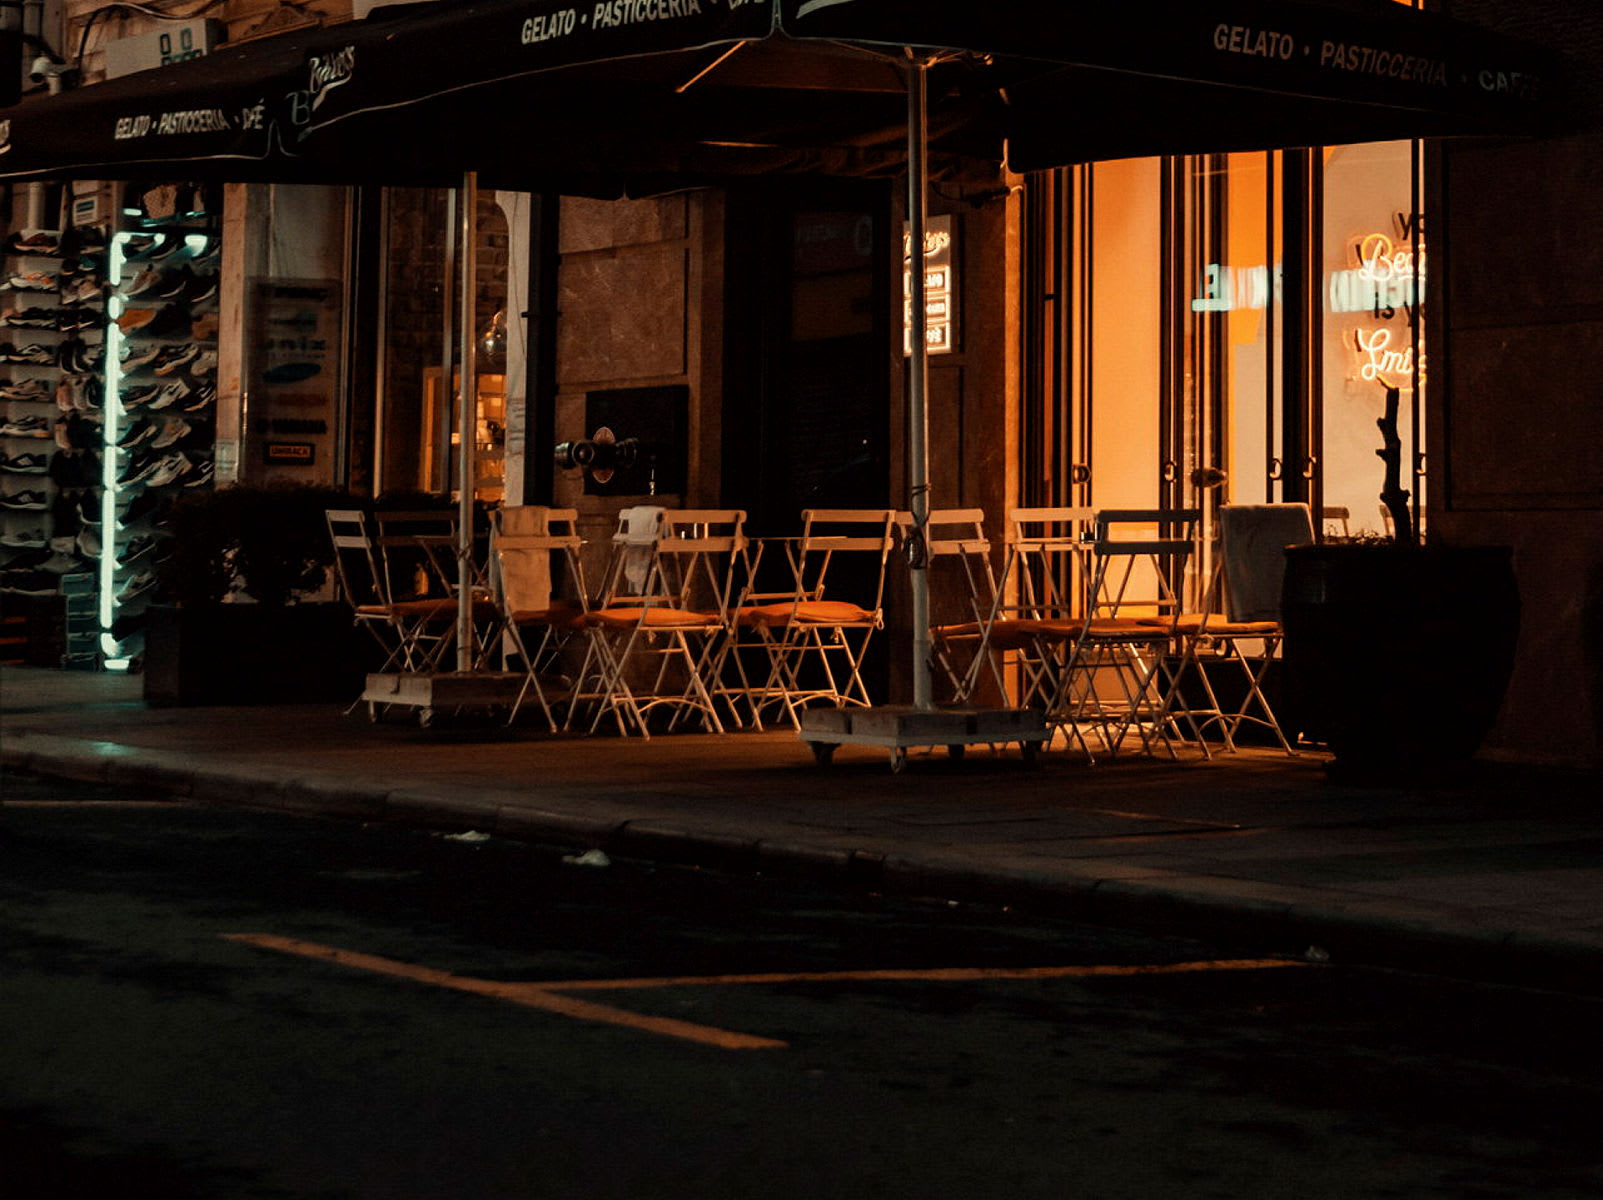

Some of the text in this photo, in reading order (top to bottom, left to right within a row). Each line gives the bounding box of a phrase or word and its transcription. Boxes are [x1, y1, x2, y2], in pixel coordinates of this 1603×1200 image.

[521, 7, 576, 45] GELATO
[1213, 22, 1295, 61] GELATO
[1320, 39, 1449, 88] PASTICCERIA
[114, 114, 151, 140] GELATO
[157, 108, 231, 135] PASTICCERIA
